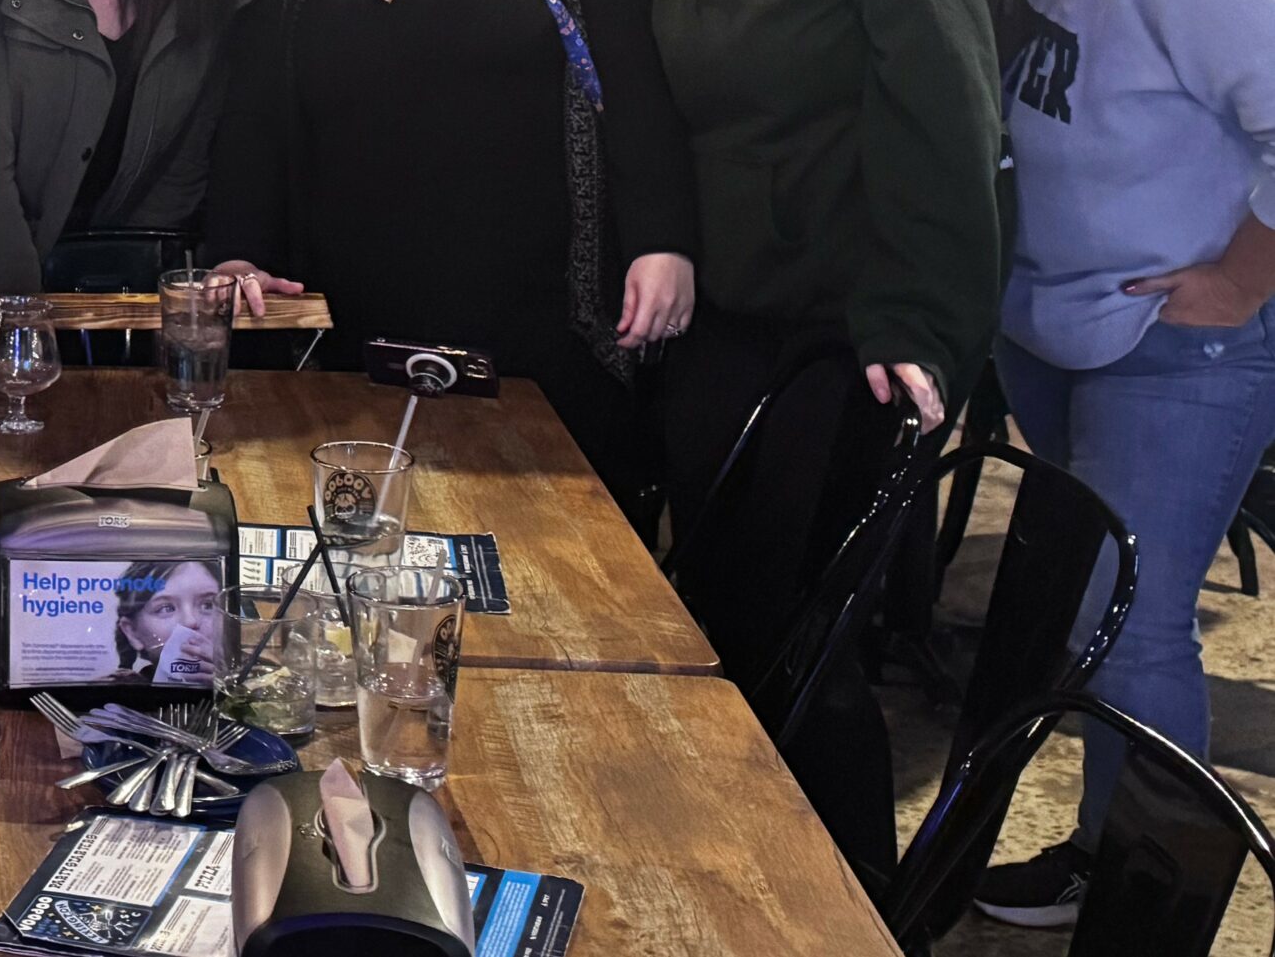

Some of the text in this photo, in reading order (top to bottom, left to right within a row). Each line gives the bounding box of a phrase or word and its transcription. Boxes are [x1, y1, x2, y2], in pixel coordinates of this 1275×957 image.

[23, 572, 166, 594] Help promote
[22, 595, 104, 617] hygiene
[172, 663, 199, 673] TORK
[49, 834, 99, 890] PARTY STARTERS
[194, 864, 221, 889] PIZZA
[56, 903, 105, 943] LEXINGTON
